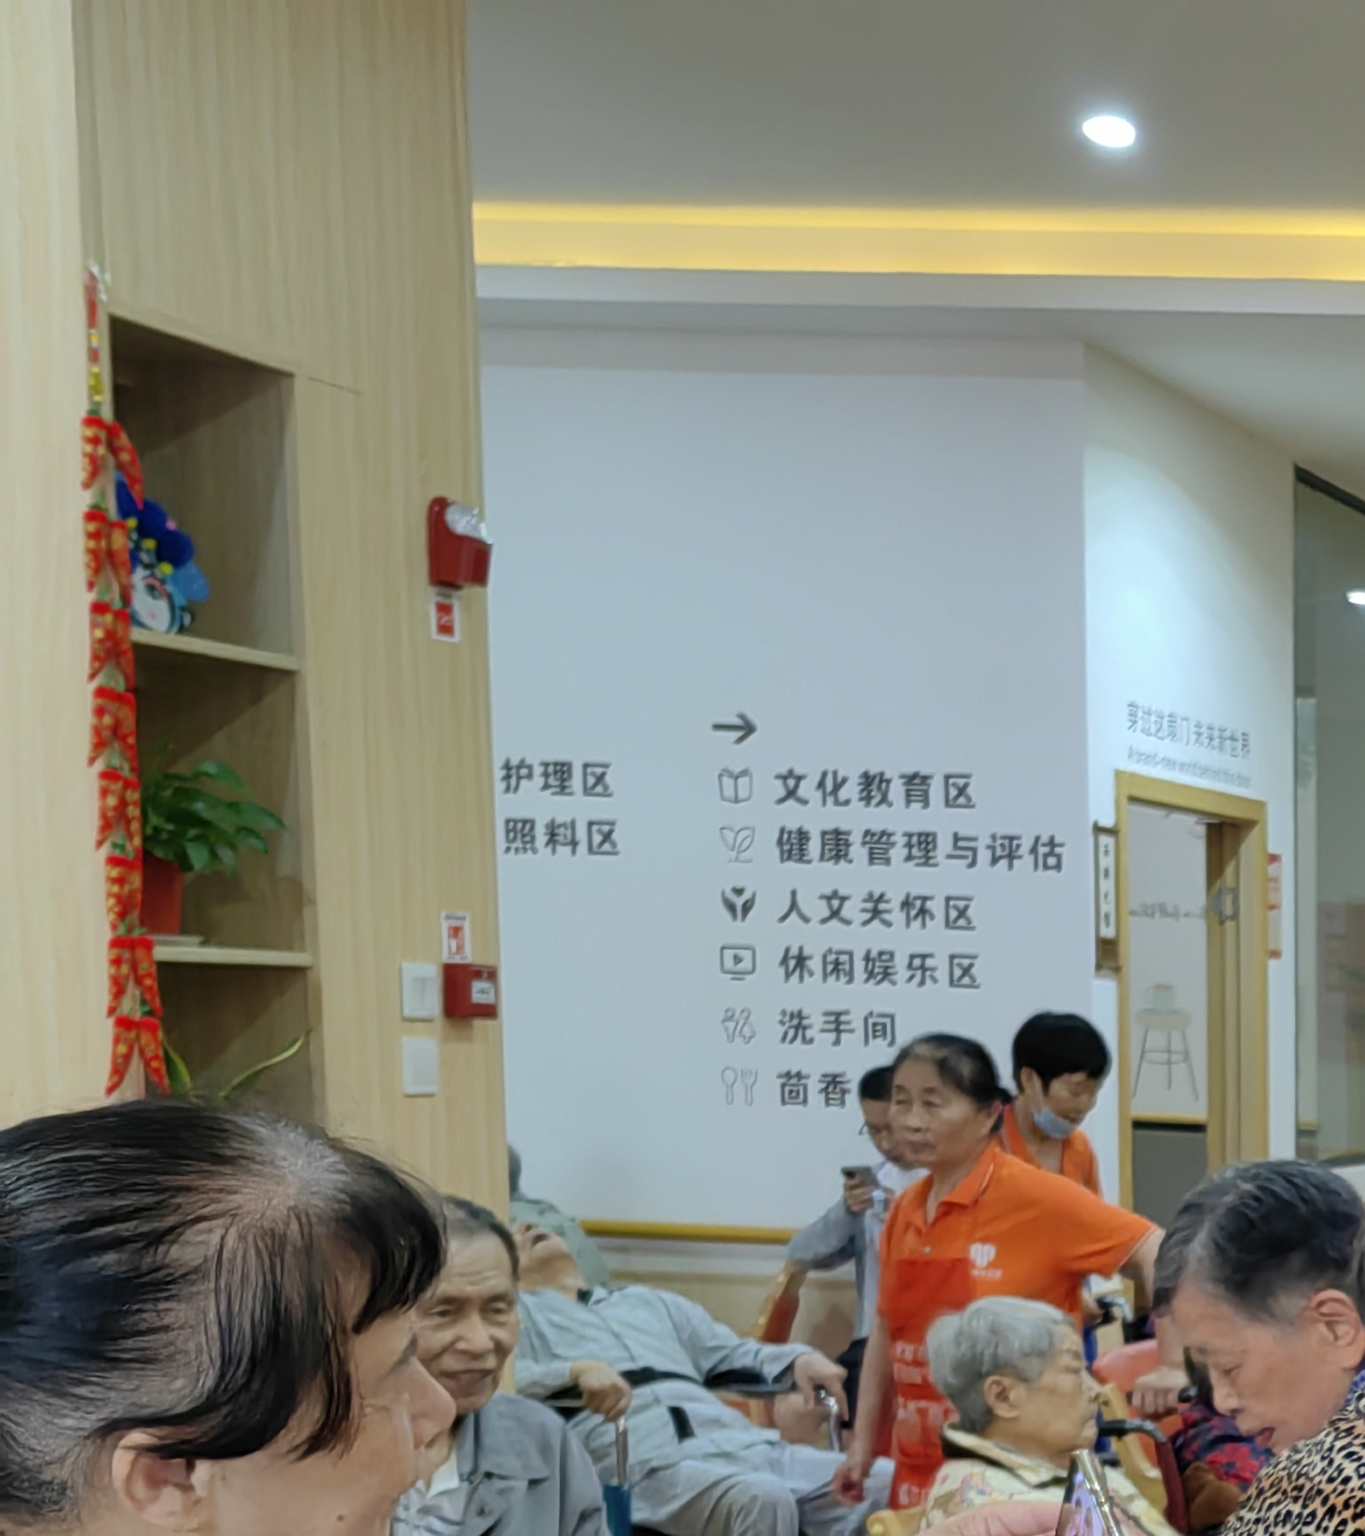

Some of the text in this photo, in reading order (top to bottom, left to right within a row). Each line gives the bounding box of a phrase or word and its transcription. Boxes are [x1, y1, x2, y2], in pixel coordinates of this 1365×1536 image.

[501, 758, 613, 797] 护理区
[774, 769, 976, 810] 文化教育区
[504, 818, 619, 856] 照料区
[776, 826, 1065, 874] 健康管理与评估
[777, 888, 976, 931] 人文关怀区
[778, 946, 980, 990] 休闲娱乐区
[778, 1008, 898, 1049] 洗手间
[776, 1069, 850, 1108] 茴香
